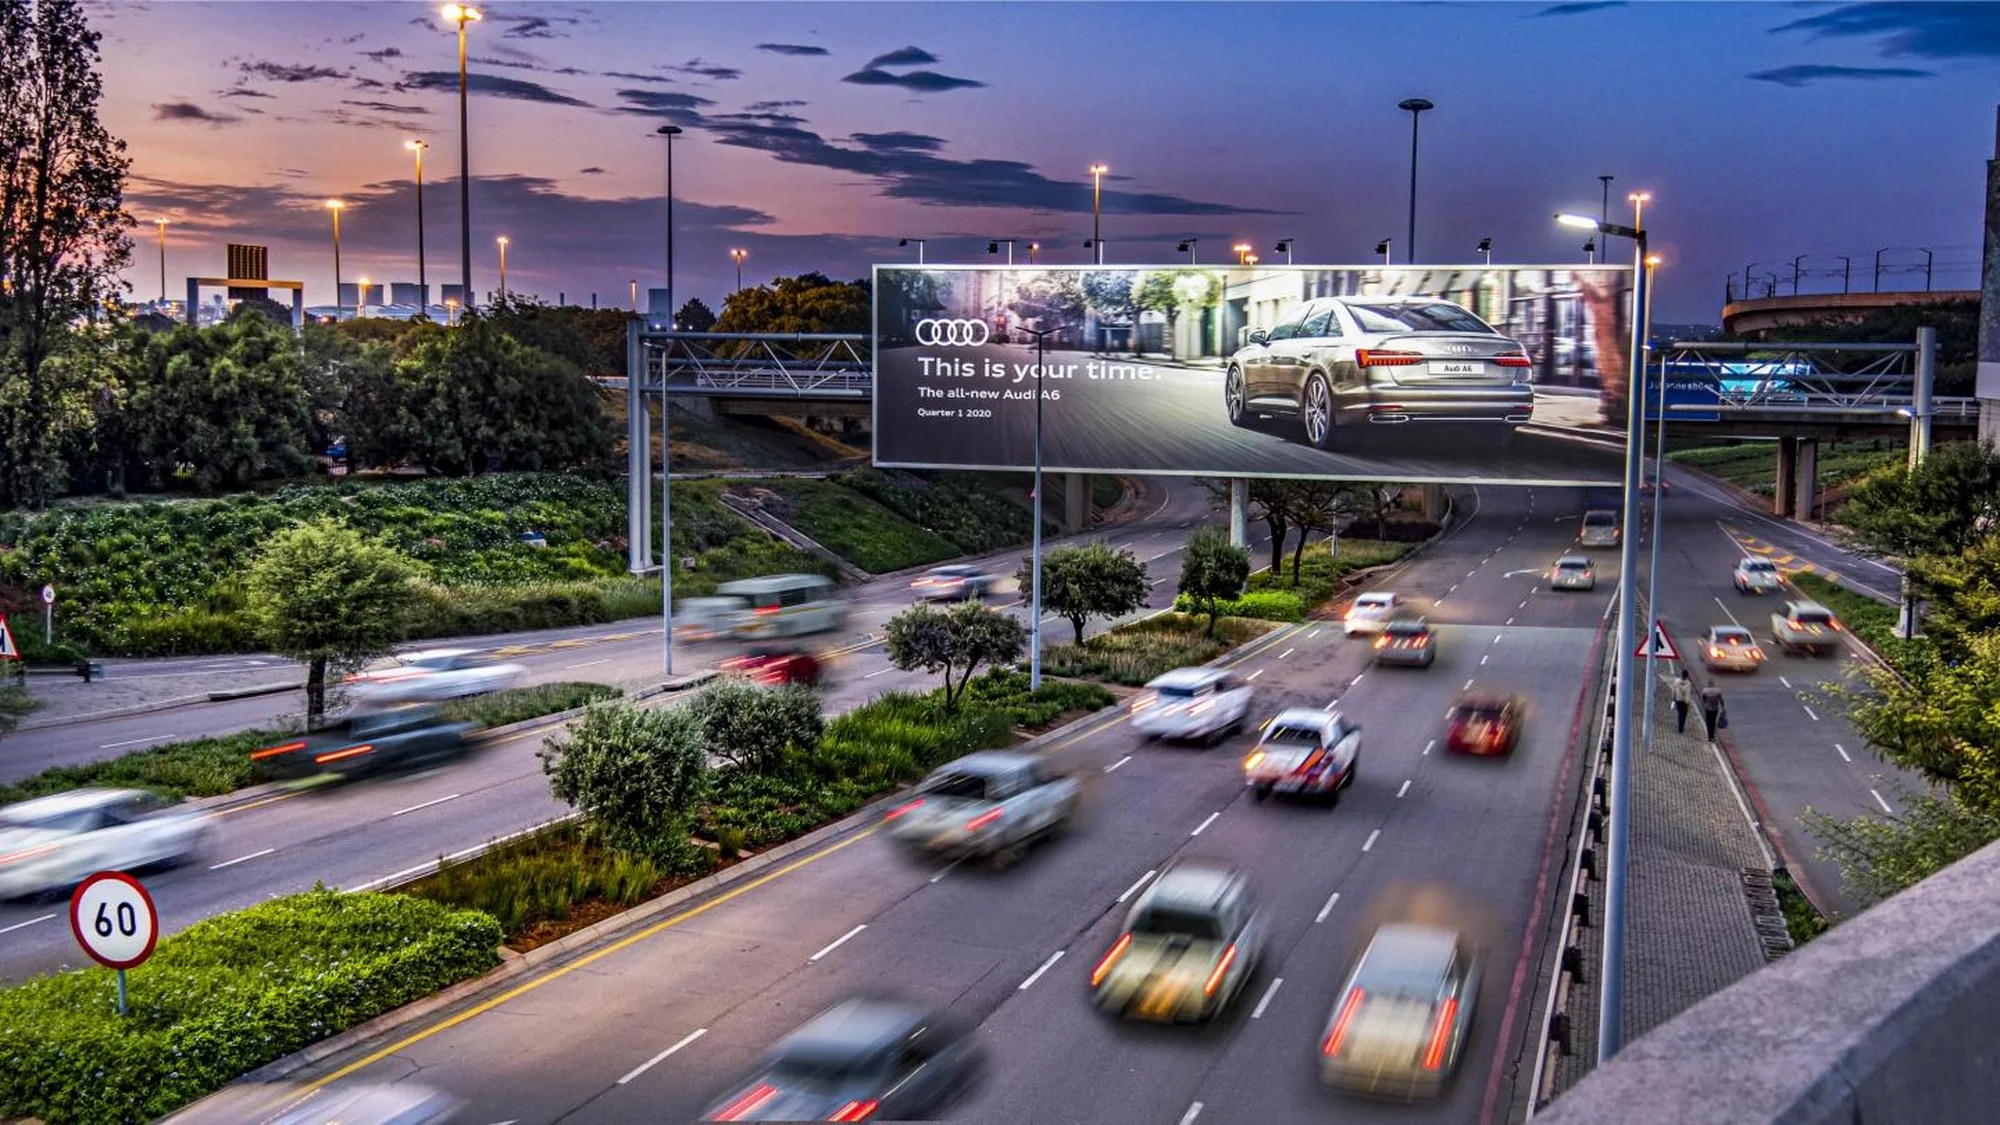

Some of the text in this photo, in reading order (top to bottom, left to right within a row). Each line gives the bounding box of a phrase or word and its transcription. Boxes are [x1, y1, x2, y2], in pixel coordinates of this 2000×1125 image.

[917, 357, 1161, 383] This is your time.
[917, 387, 1061, 400] The all-new Audi A6
[917, 408, 992, 418] Quarter 1 2020
[95, 901, 136, 937] 60
